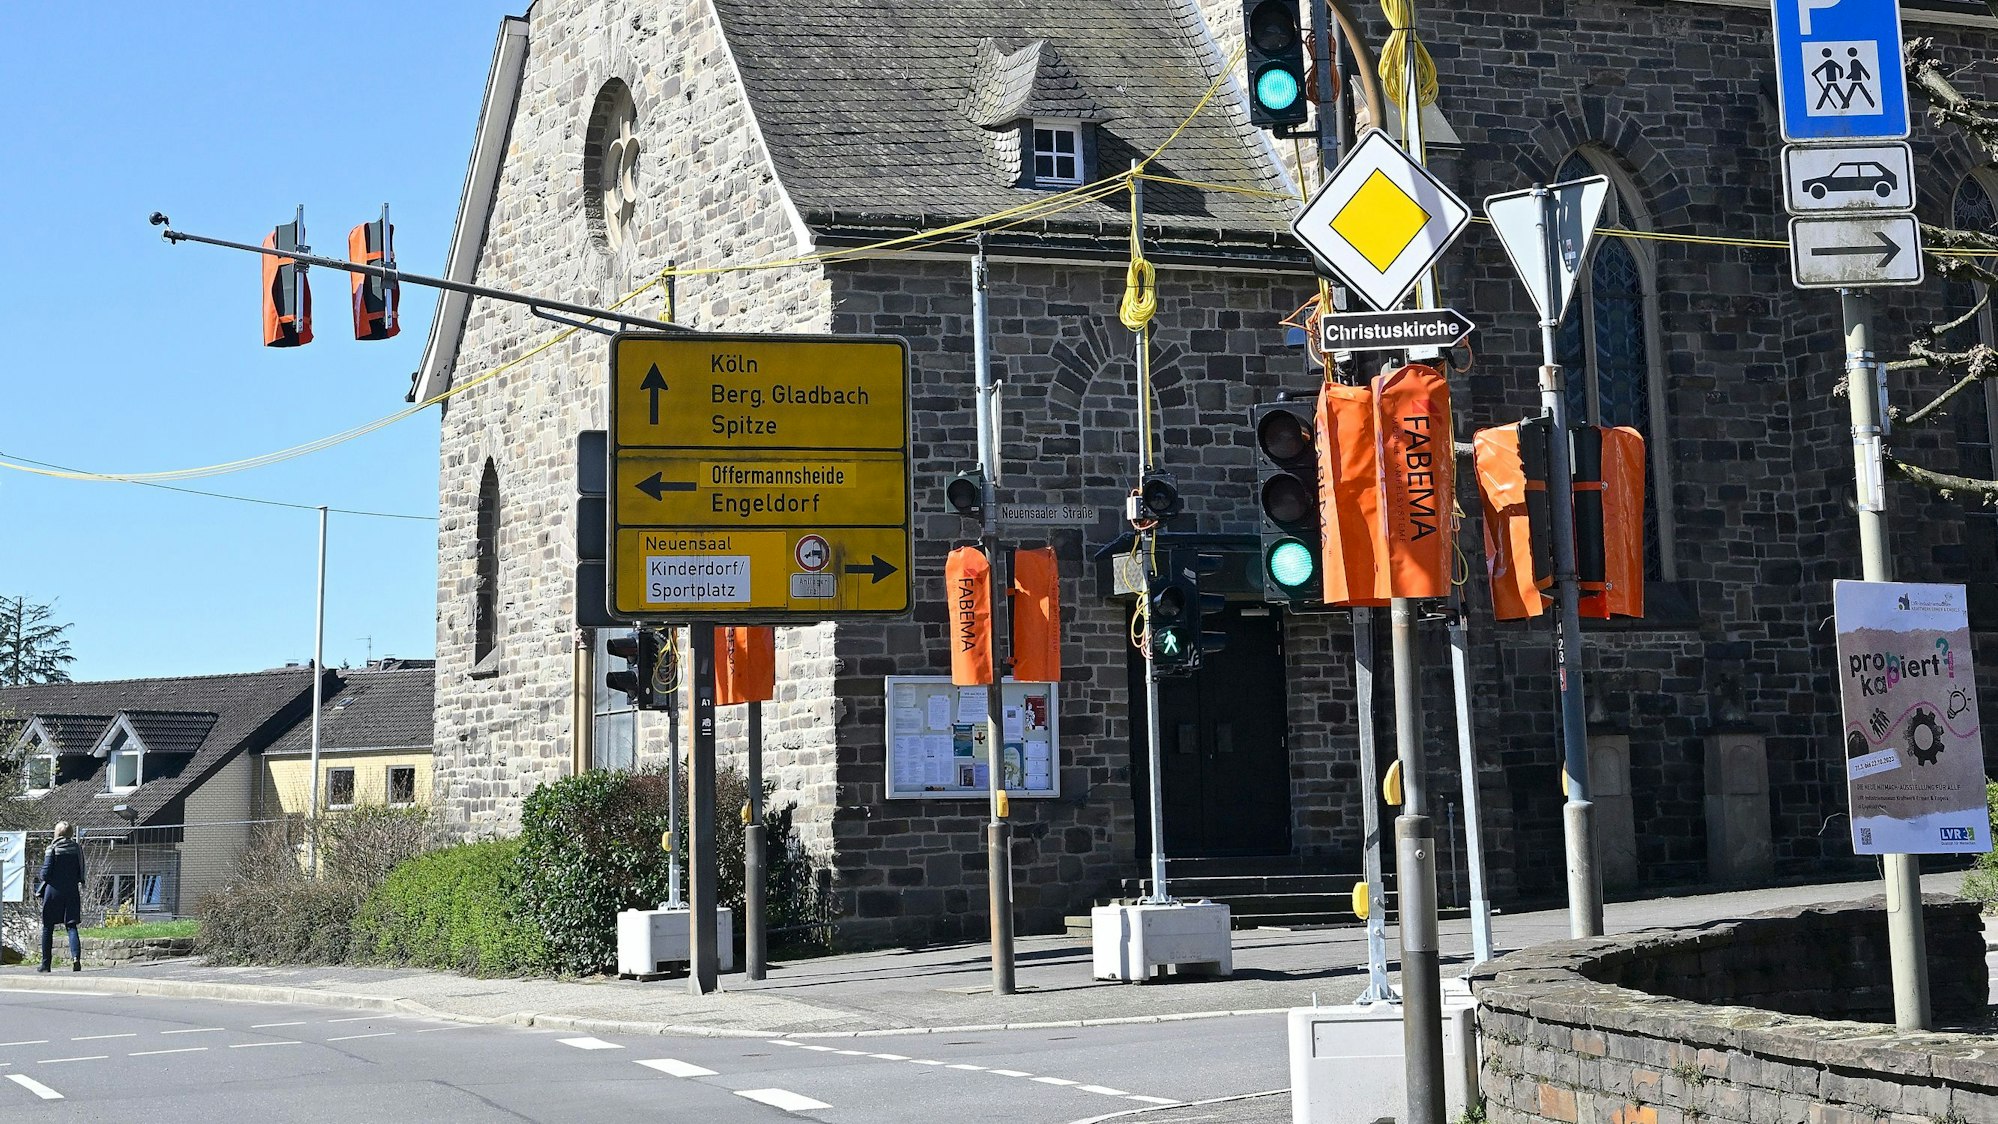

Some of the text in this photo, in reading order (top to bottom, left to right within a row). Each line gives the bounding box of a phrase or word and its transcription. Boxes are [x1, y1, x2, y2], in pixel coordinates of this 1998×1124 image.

[1325, 319, 1460, 342] Christuskirche
[711, 353, 758, 373] Köln
[711, 384, 869, 408] Berg. Gladbach
[711, 414, 777, 439] Spitze
[712, 465, 844, 484] Offermannsheide
[1403, 415, 1437, 542] FABEMA
[711, 493, 820, 517] Engeldorf
[1002, 506, 1093, 519] Neuensaaler Straße
[645, 535, 732, 551] Neuensaal
[651, 561, 745, 576] Kinderdorf/
[651, 582, 736, 601] Sportplatz
[958, 578, 976, 653] FABEMA
[1941, 828, 1961, 840] LVR
